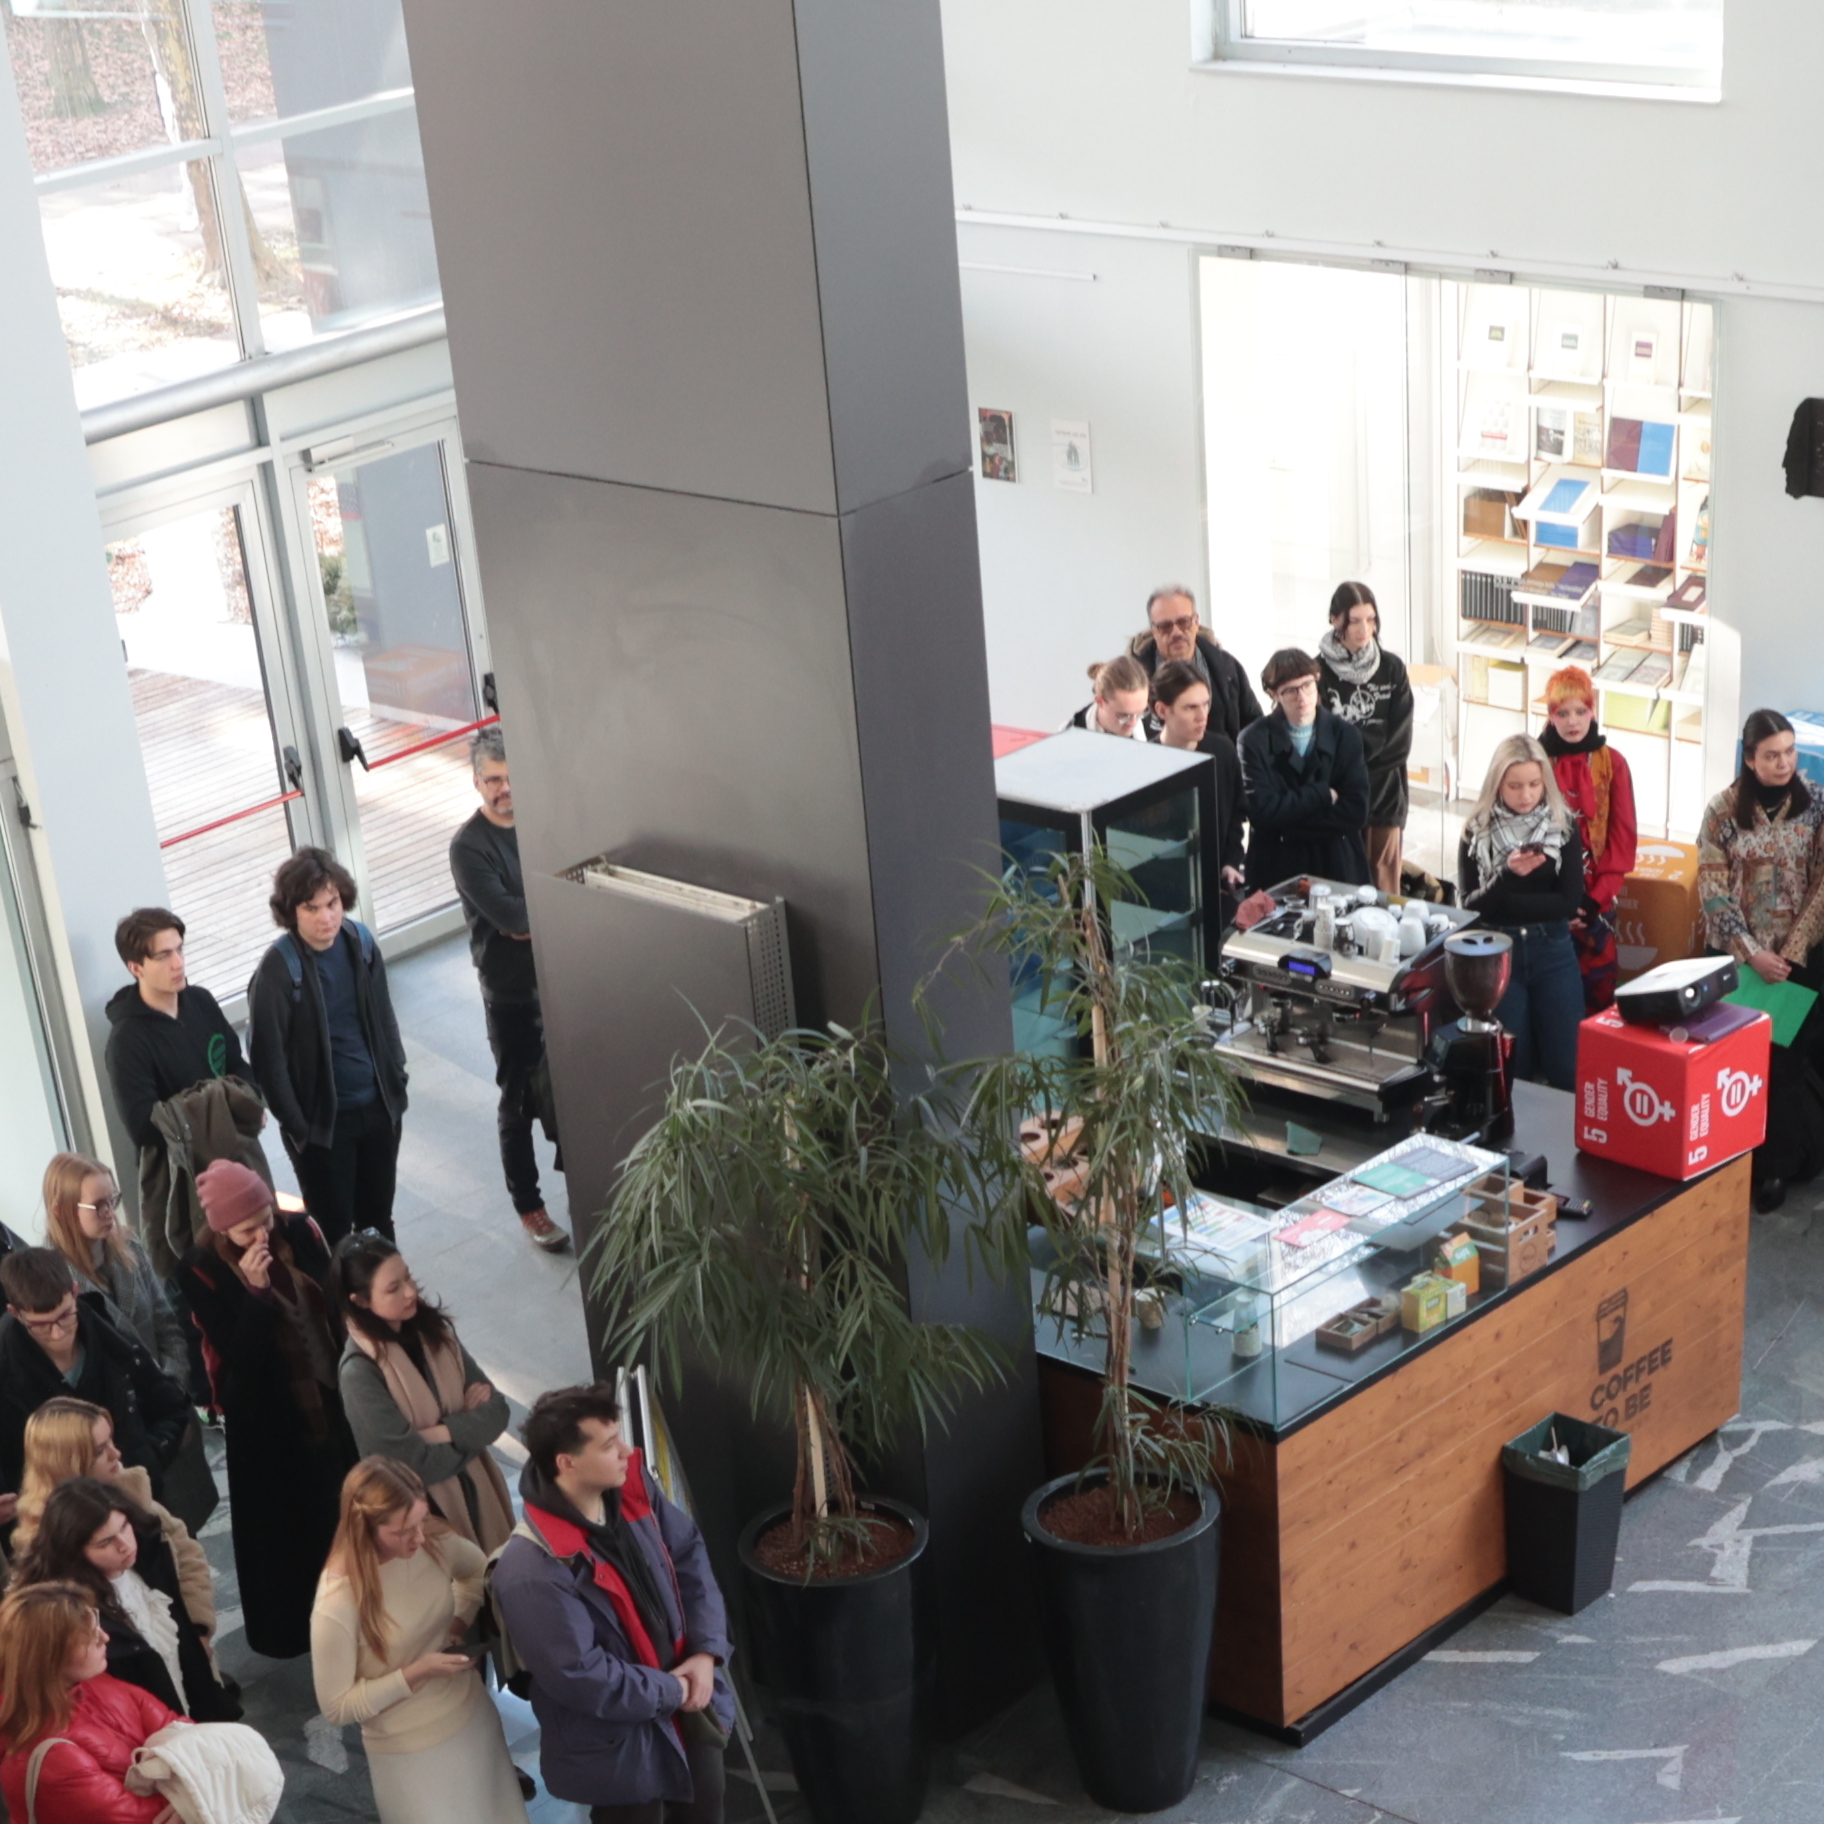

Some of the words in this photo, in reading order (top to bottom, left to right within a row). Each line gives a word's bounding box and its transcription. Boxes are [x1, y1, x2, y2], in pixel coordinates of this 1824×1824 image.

[1584, 1081, 1595, 1118] GENDER
[1597, 1077, 1608, 1121] EQUALITY
[1699, 1093, 1711, 1138] EQUALITY
[1583, 1126, 1608, 1144] 5
[1689, 1103, 1700, 1141] GENDER
[1688, 1145, 1708, 1166] 5
[1590, 1337, 1674, 1411] COFFEE
[1625, 1382, 1652, 1421] BE
